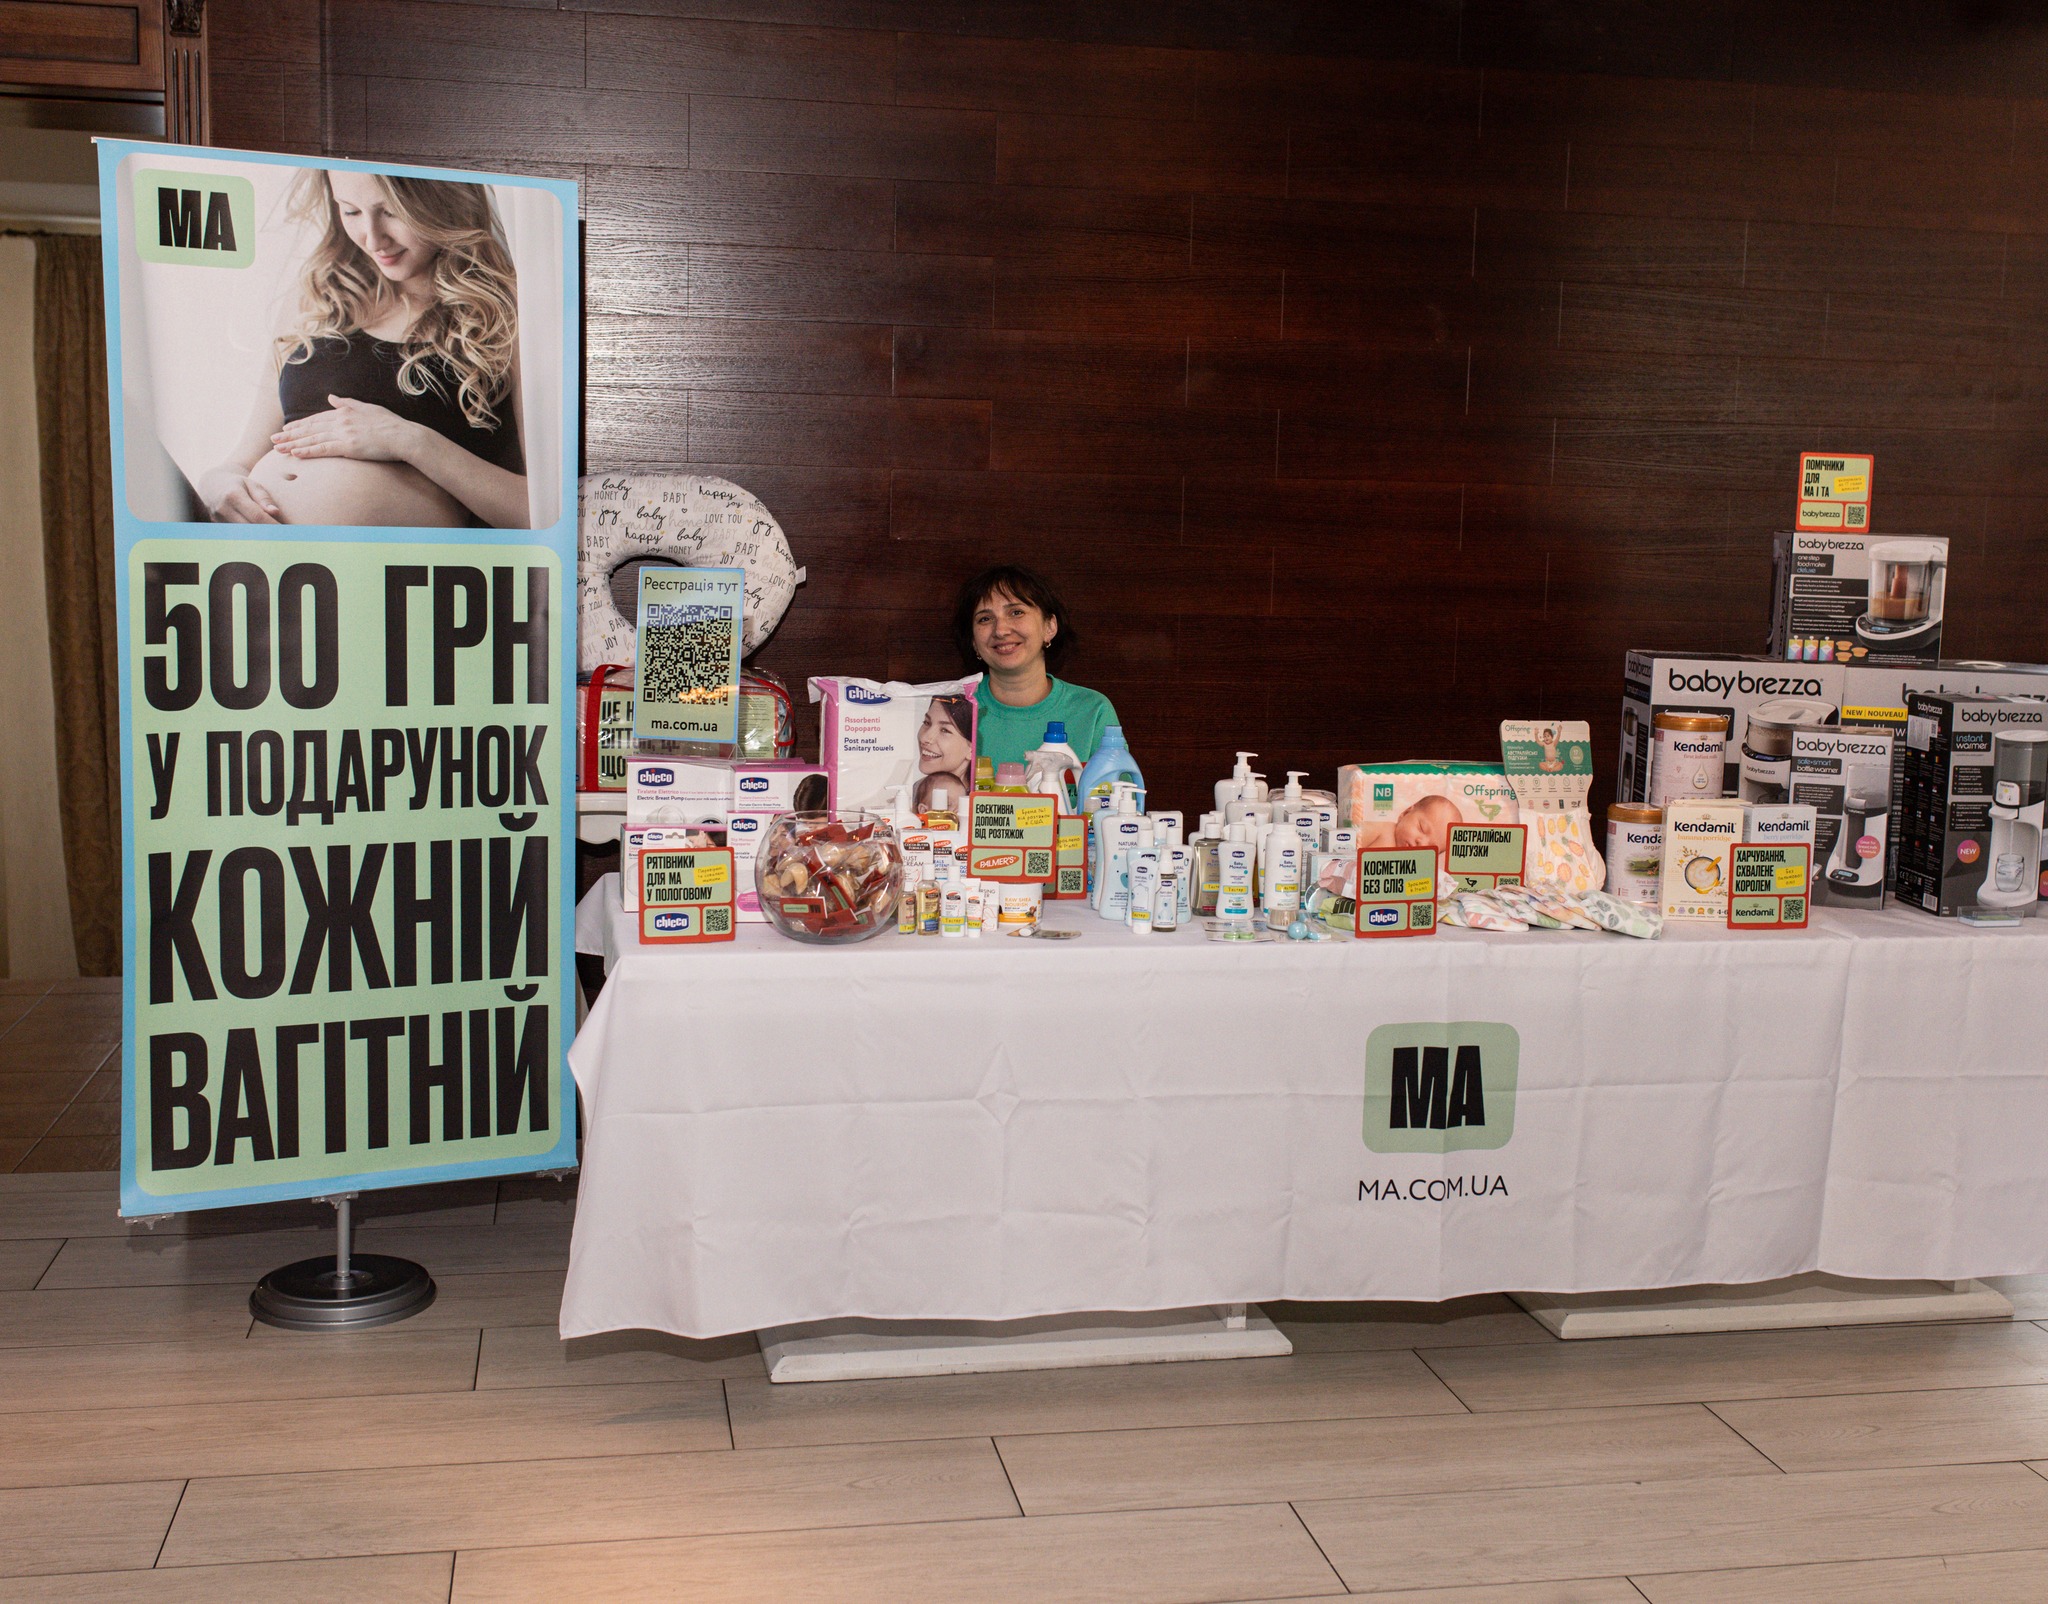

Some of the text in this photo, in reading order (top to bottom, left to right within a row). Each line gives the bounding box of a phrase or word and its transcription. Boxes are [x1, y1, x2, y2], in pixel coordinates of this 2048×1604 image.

[1806, 459, 1844, 471] ПОМІЧНИКИ
[1805, 473, 1820, 484] ДЛЯ
[594, 490, 618, 500] HONEY
[602, 478, 632, 500] baby
[699, 485, 737, 500] happy
[1804, 487, 1814, 496] МА
[1821, 487, 1830, 497] ТА
[663, 491, 687, 504] BABY
[599, 506, 621, 526] joy
[636, 506, 666, 530] baby
[705, 514, 743, 524] LOVE YOU
[752, 516, 774, 537] joy
[587, 536, 610, 548] BABY
[626, 527, 663, 544] happy
[677, 528, 707, 550] baby
[734, 542, 760, 556] BABY
[720, 554, 735, 565] JOY
[644, 576, 739, 595] Реєстрація тут
[744, 583, 765, 609] aby
[144, 561, 549, 711] 500 ГРН
[604, 635, 618, 650] JOY
[1669, 667, 1822, 700] babybrezza
[1868, 710, 1904, 718] NOUVEAU
[1962, 708, 2042, 726] babybrezza
[651, 719, 718, 733] ma.com.ua
[844, 725, 881, 733] Dopoparto
[1956, 735, 1983, 743] instant
[844, 745, 870, 754] Sanitary
[1797, 737, 1887, 756] babybrezza
[1957, 742, 1987, 751] warmer
[146, 725, 549, 826] У ПОДАРУНОК
[639, 769, 673, 785] chicco
[741, 778, 767, 791] chicco
[1376, 787, 1392, 797] NB
[1464, 784, 1516, 801] Offspring
[976, 804, 1014, 815] ЕФЕКТИВНА
[732, 820, 757, 831] chicco
[975, 816, 1010, 828] ДОПОМОГА
[1674, 821, 1735, 834] Kendamil
[1758, 820, 1810, 832] Kendamil
[975, 829, 1024, 840] ВІД РОЗТЯЖОК
[1453, 829, 1511, 844] АВСТРАЛІЙСЬКІ
[1627, 832, 1662, 844] Kenda
[1703, 834, 1731, 843] porridge
[1452, 845, 1489, 858] ПІДГУЗКИ
[1736, 850, 1786, 863] ХАРЧУВАННЯ,
[647, 855, 695, 869] РЯТІВНИКИ
[980, 854, 1018, 869] PALMER'S
[1364, 860, 1417, 876] КОСМЕТИКА
[1736, 865, 1774, 877] СХВАЛЕНЕ
[647, 873, 665, 886] ДЛЯ
[669, 872, 681, 885] МА
[1363, 878, 1404, 894] БЕЗ СЛІЗ
[1735, 880, 1771, 892] КОРОЛЕМ
[647, 887, 712, 901] У ПОЛОГОВОМУ
[148, 812, 549, 1005] КОЖНІЙ
[1735, 908, 1775, 917] Kendamil
[656, 914, 688, 928] chicco
[1370, 910, 1397, 923] chicco
[149, 983, 549, 1171] ВАГІТНІЙ
[1358, 1175, 1509, 1201] MA.COM.UA
